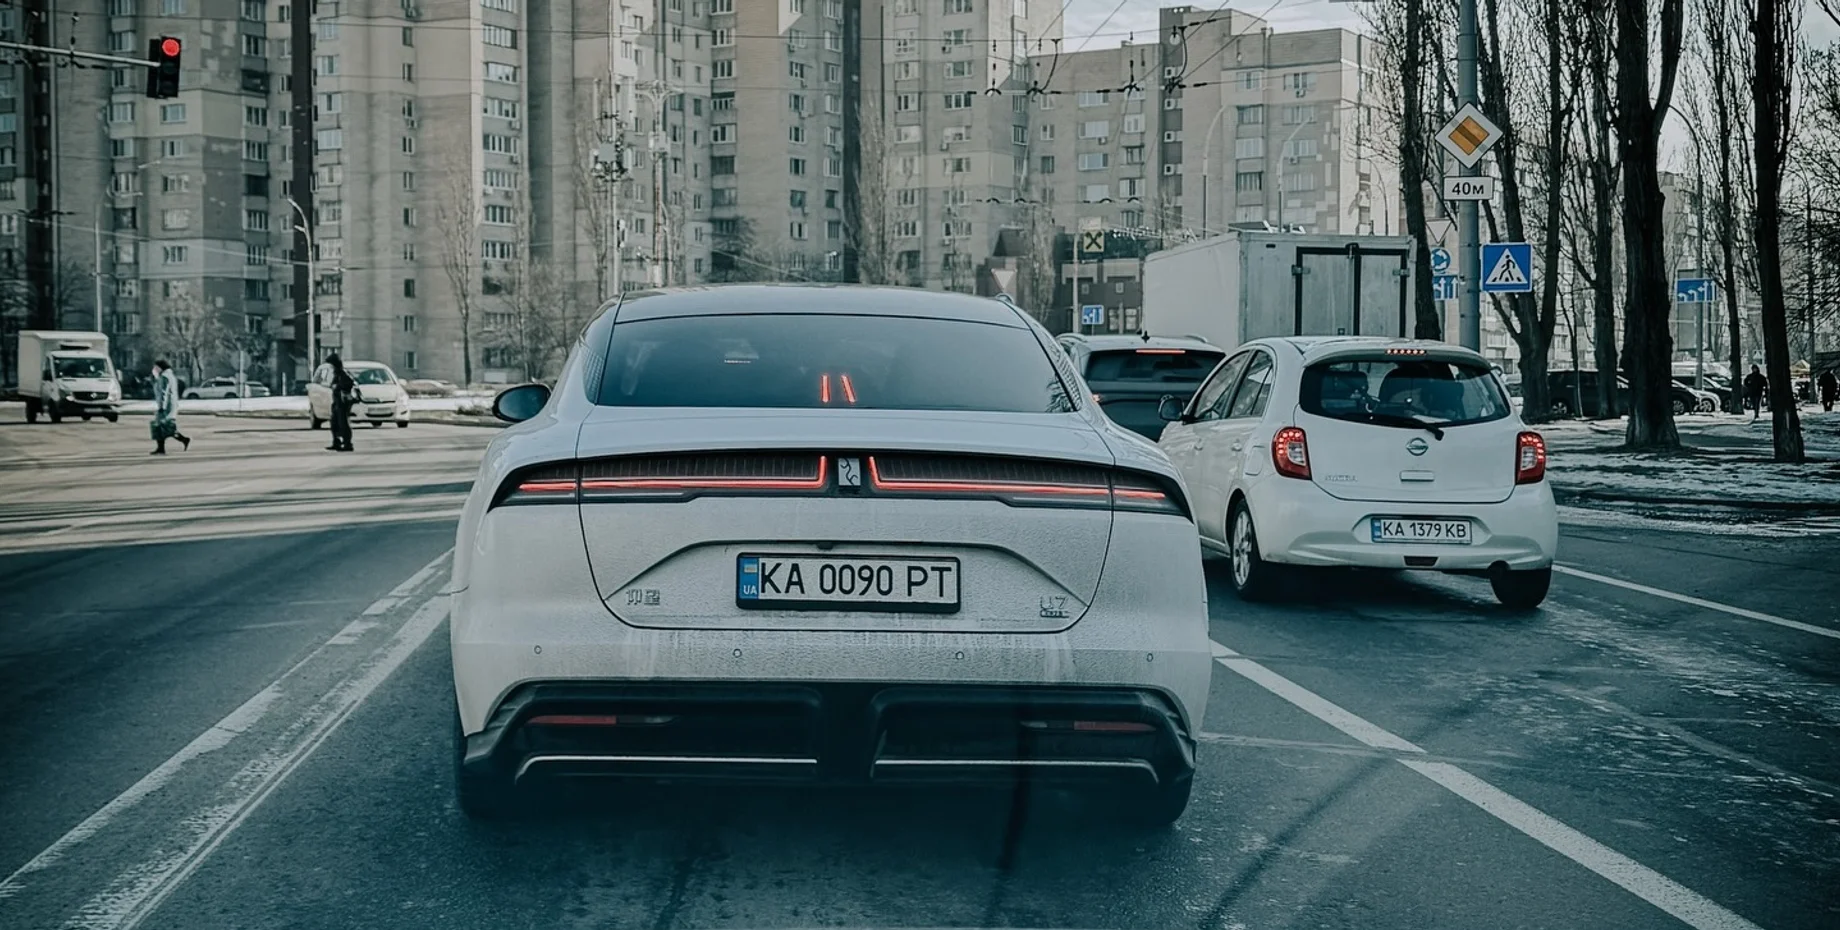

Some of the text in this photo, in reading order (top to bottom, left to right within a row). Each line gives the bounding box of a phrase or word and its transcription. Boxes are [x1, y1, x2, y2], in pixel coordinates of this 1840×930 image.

[1383, 521, 1467, 538] KA 1379 KB
[760, 562, 952, 597] KA 0090 PT
[743, 585, 758, 595] UA
